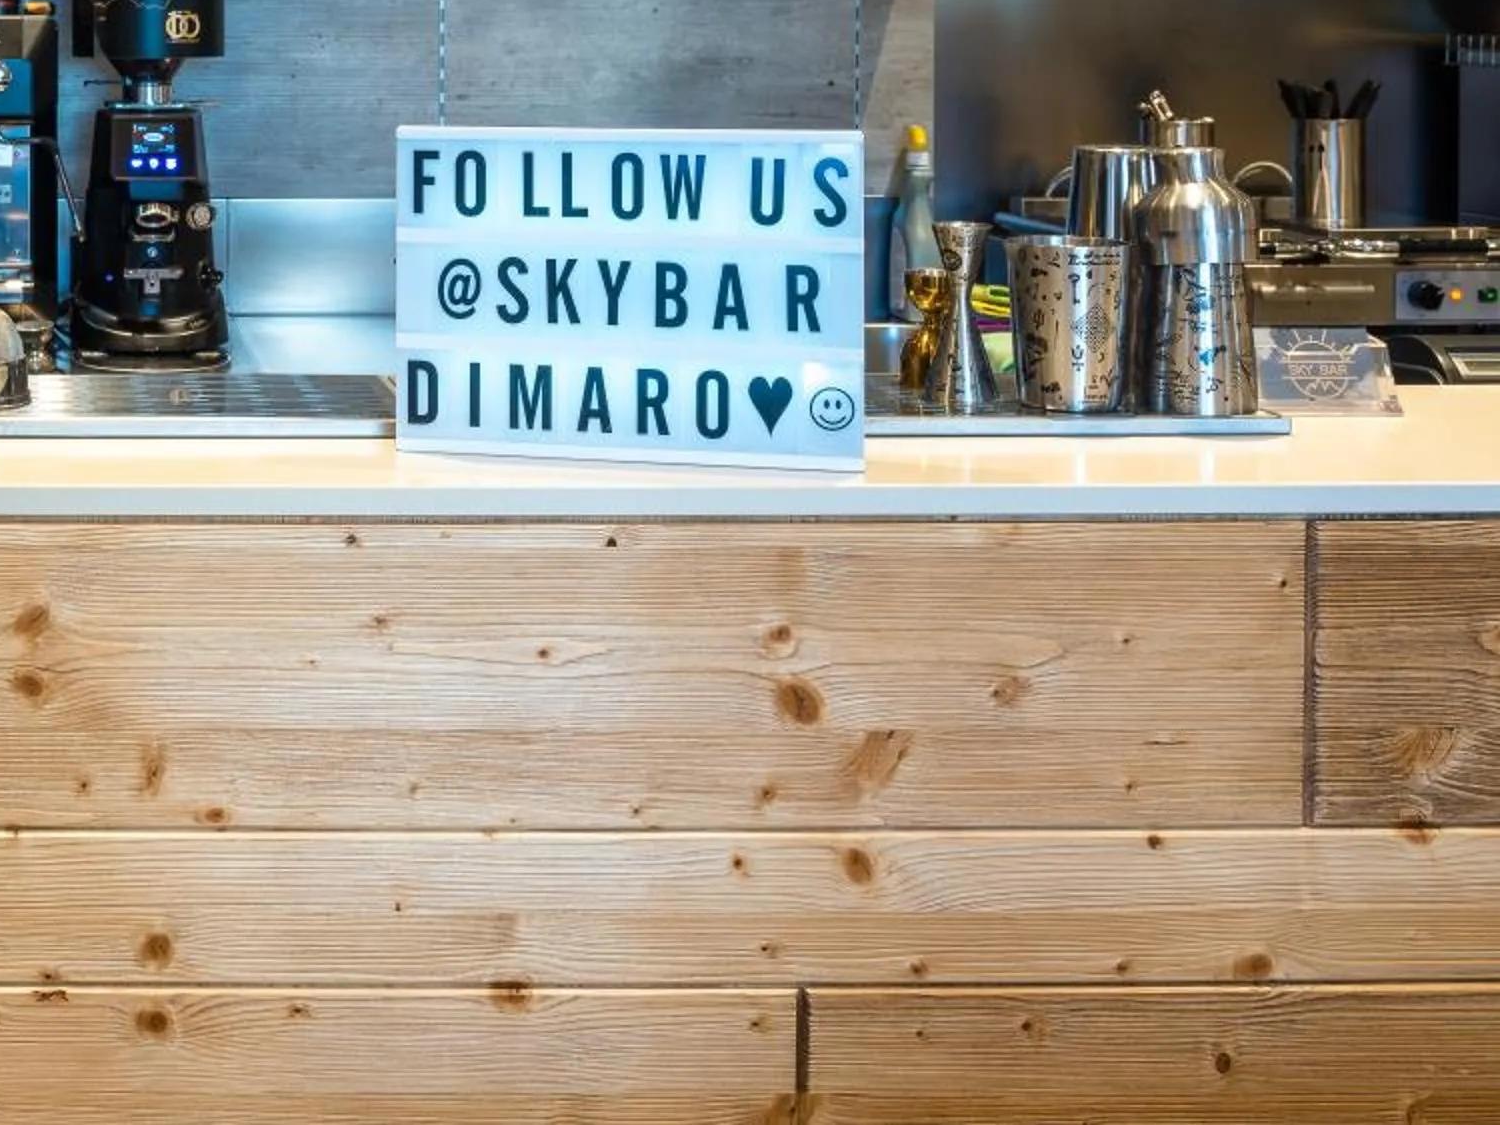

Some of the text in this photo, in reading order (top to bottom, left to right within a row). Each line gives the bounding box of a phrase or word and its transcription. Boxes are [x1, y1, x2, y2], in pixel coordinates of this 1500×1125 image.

[412, 149, 849, 227] FOLLOW US
[437, 256, 822, 333] @SKYBAR
[406, 359, 731, 440] DIMARO
